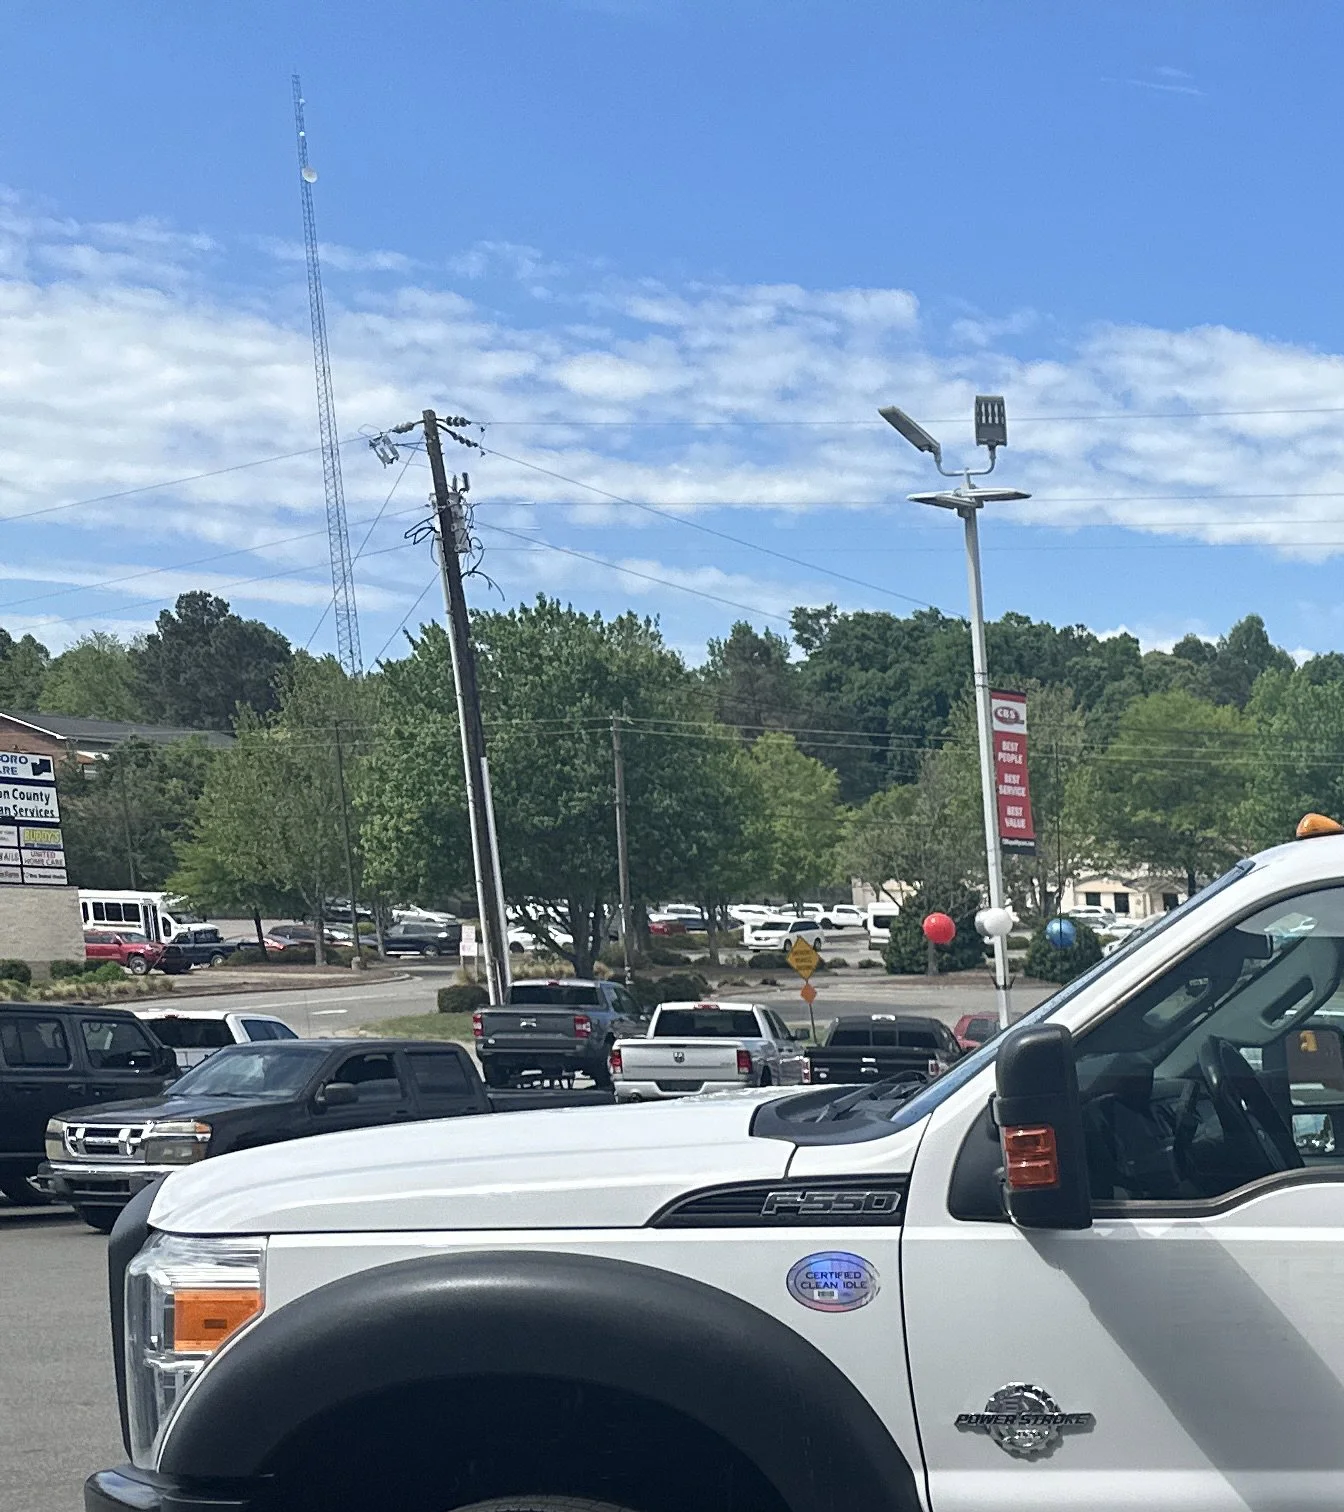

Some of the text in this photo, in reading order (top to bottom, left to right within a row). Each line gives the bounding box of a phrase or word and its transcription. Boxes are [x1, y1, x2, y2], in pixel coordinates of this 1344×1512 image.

[996, 708, 1017, 720] CBS
[1001, 740, 1019, 752] BEST
[0, 754, 28, 764] ORO
[998, 752, 1023, 765] PEOPLE
[1003, 772, 1021, 784] BEST
[12, 788, 50, 805] County
[998, 784, 1027, 797] SERVICE
[12, 804, 56, 818] Services
[1006, 805, 1024, 817] BEST
[1004, 817, 1027, 829] VALUE
[760, 1191, 902, 1216] F-550
[805, 1271, 862, 1280] CERTIFIED
[800, 1281, 868, 1290] CLEAN IDLE
[955, 1413, 1092, 1425] POWER STROKE
